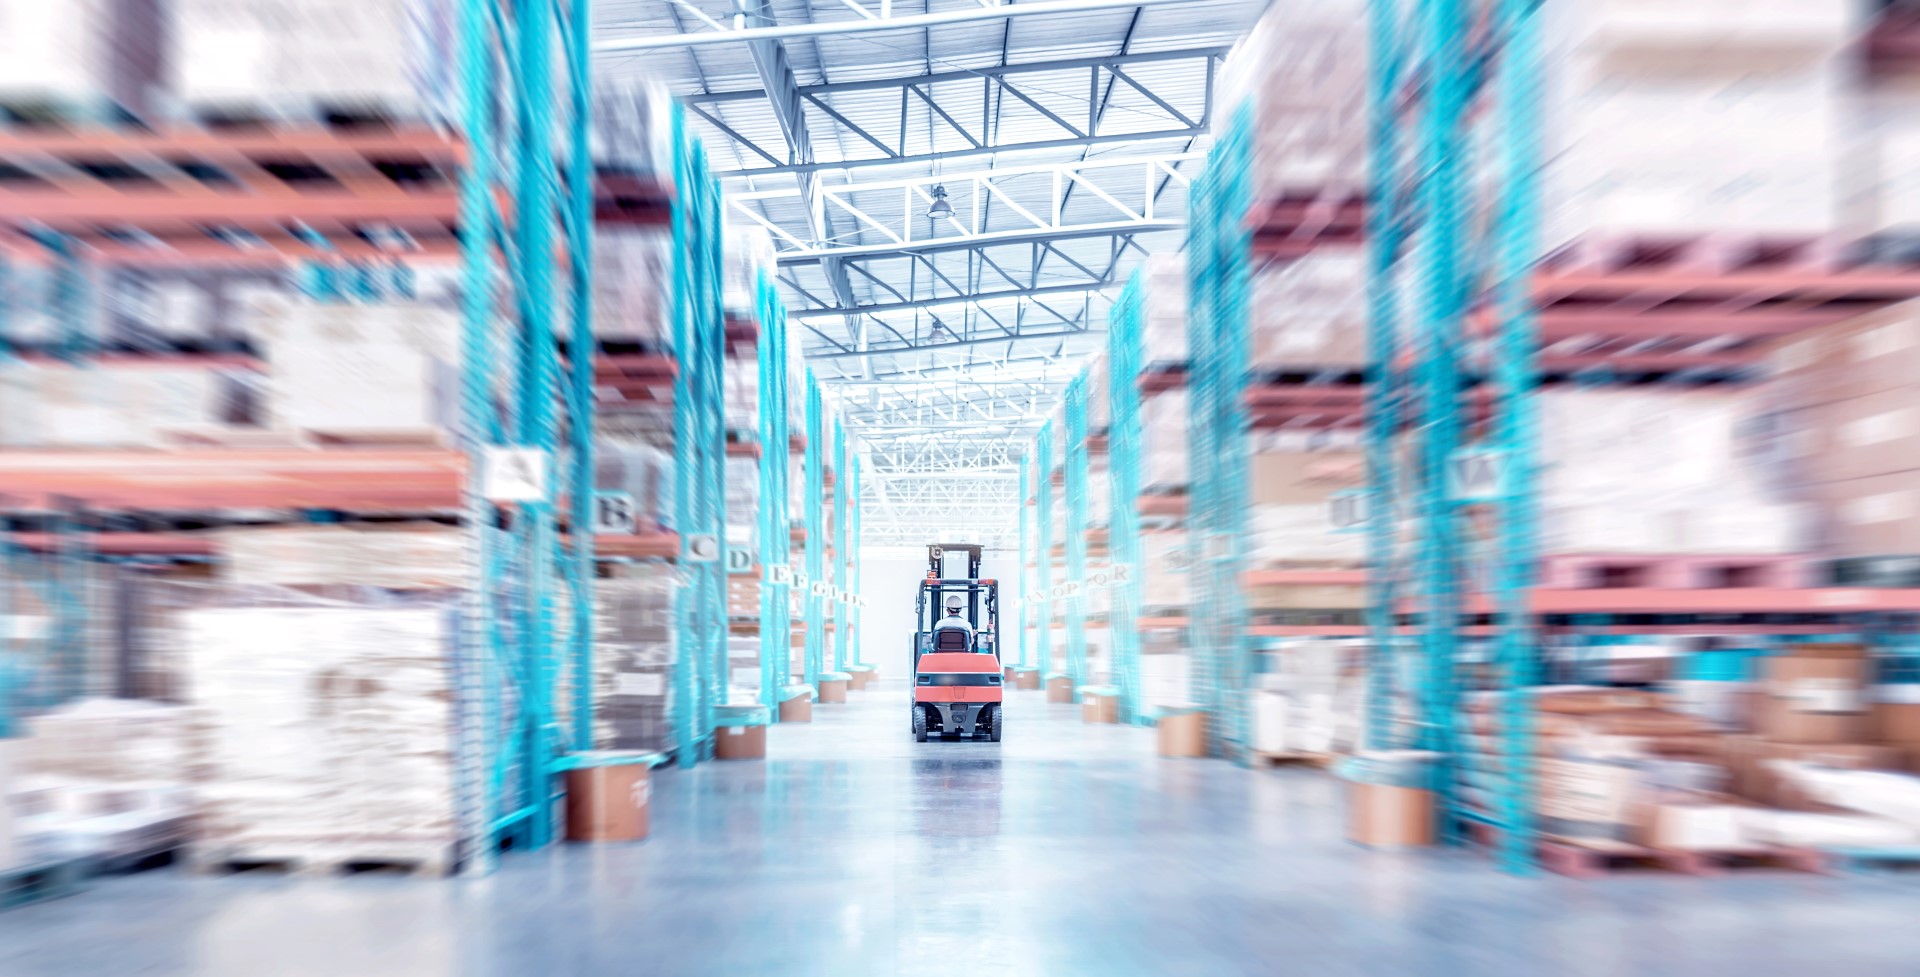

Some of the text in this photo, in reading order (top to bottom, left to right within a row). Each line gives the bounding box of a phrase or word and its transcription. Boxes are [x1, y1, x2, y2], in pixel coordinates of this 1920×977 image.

[598, 497, 633, 526] B
[690, 537, 715, 557] C
[730, 550, 749, 569] D
[774, 567, 788, 581] E
[1093, 573, 1106, 586] Q
[1113, 566, 1126, 581] R
[793, 574, 807, 587] F
[813, 583, 826, 595] G
[1052, 587, 1063, 598] O
[1066, 583, 1077, 595] P
